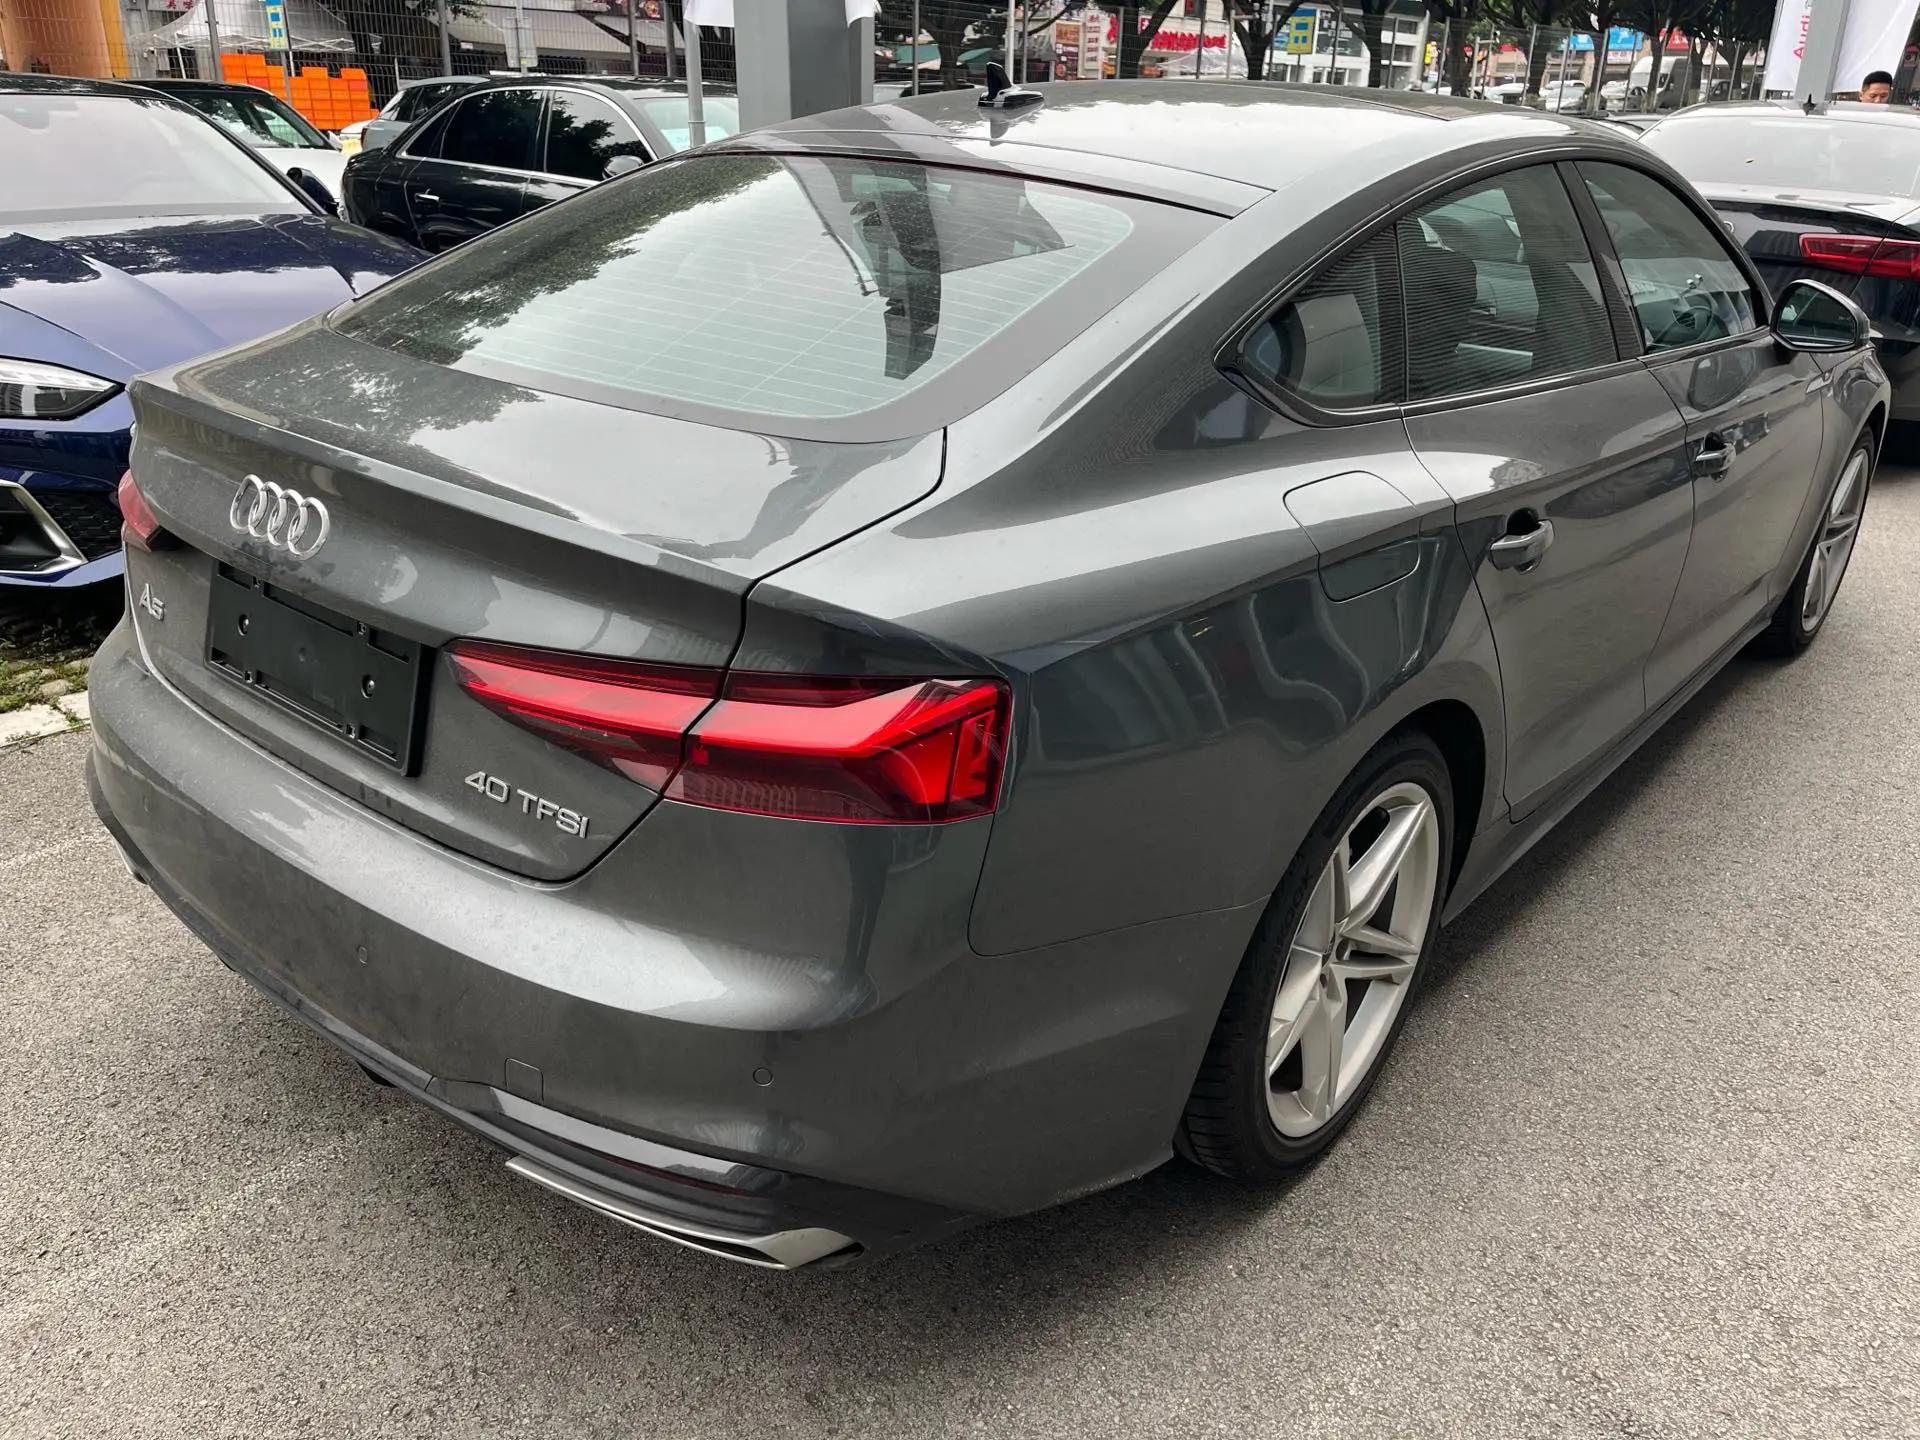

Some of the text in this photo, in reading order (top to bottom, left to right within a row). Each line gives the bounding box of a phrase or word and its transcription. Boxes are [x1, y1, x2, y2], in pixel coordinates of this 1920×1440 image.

[139, 583, 164, 620] A5
[464, 771, 590, 838] 40 TFSI
